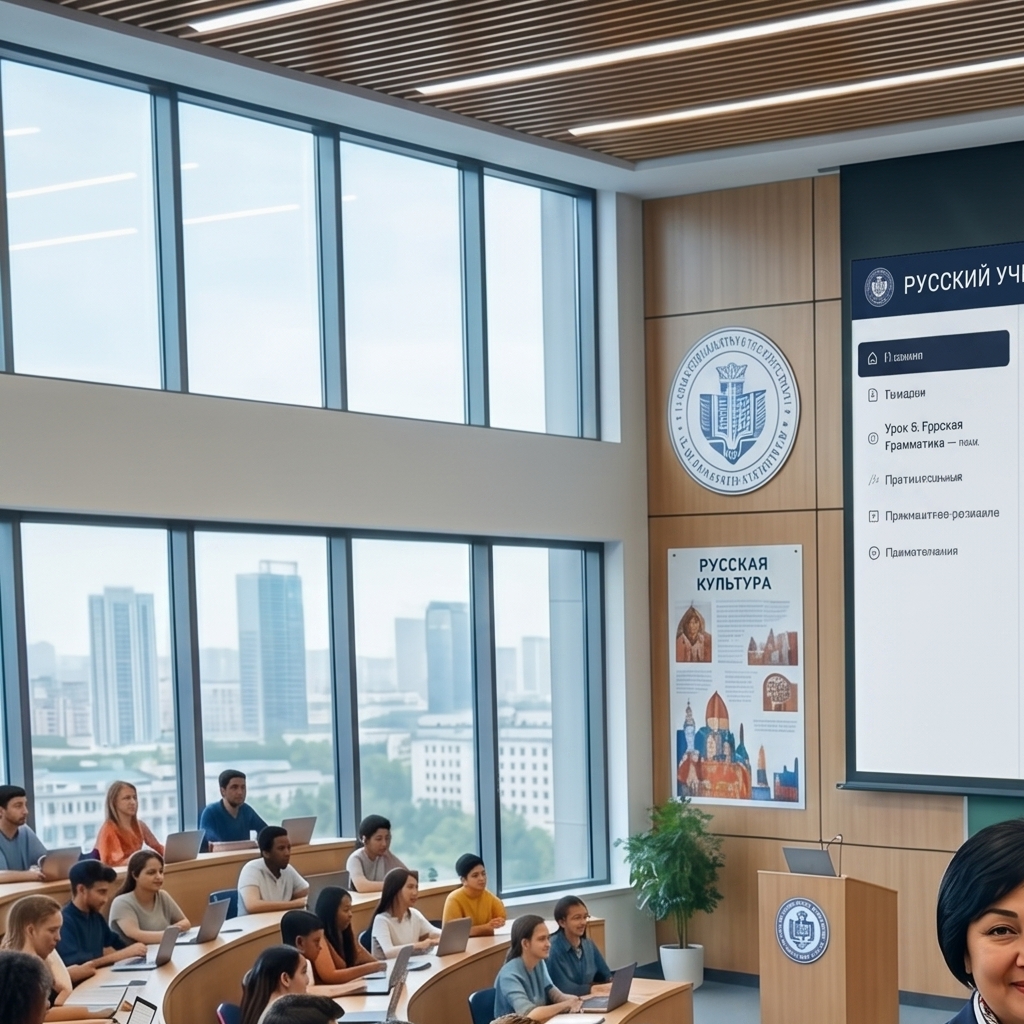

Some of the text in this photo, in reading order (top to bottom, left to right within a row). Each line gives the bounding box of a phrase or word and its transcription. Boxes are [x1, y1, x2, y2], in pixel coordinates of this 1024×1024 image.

[904, 263, 990, 295] РУССКИЙ
[884, 422, 909, 437] Урок
[699, 556, 768, 573] РУССКАЯ
